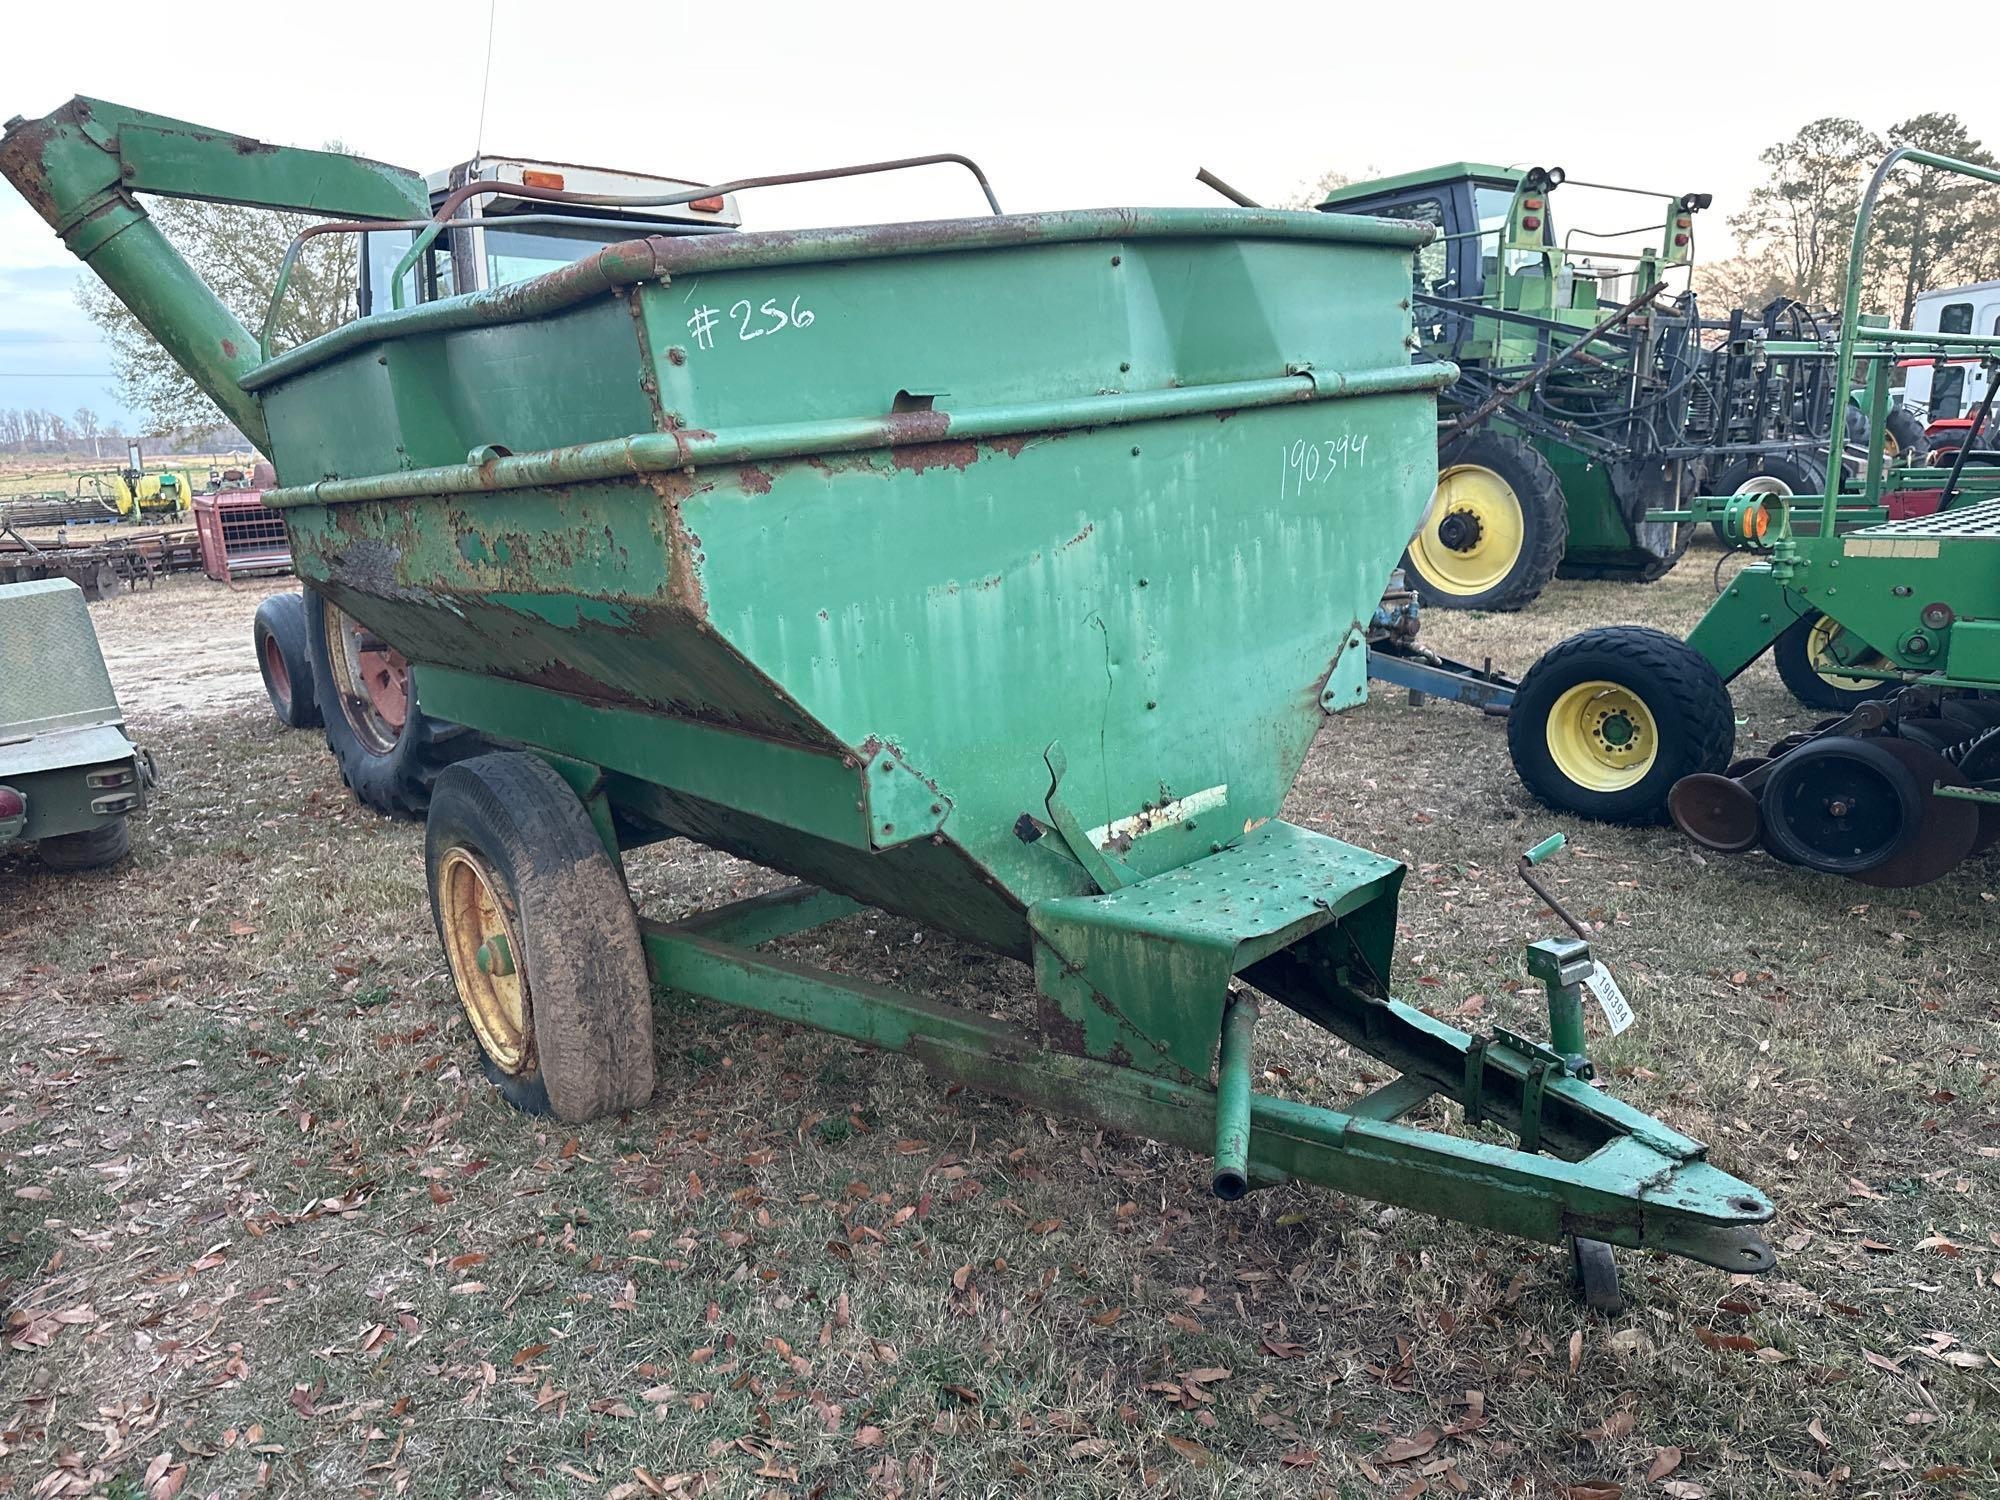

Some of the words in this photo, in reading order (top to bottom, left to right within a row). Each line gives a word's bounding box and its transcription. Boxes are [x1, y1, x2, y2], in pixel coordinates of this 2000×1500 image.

[686, 292, 815, 350] #256
[1281, 433, 1369, 501] 190394
[1599, 976, 1628, 1023] 190394
